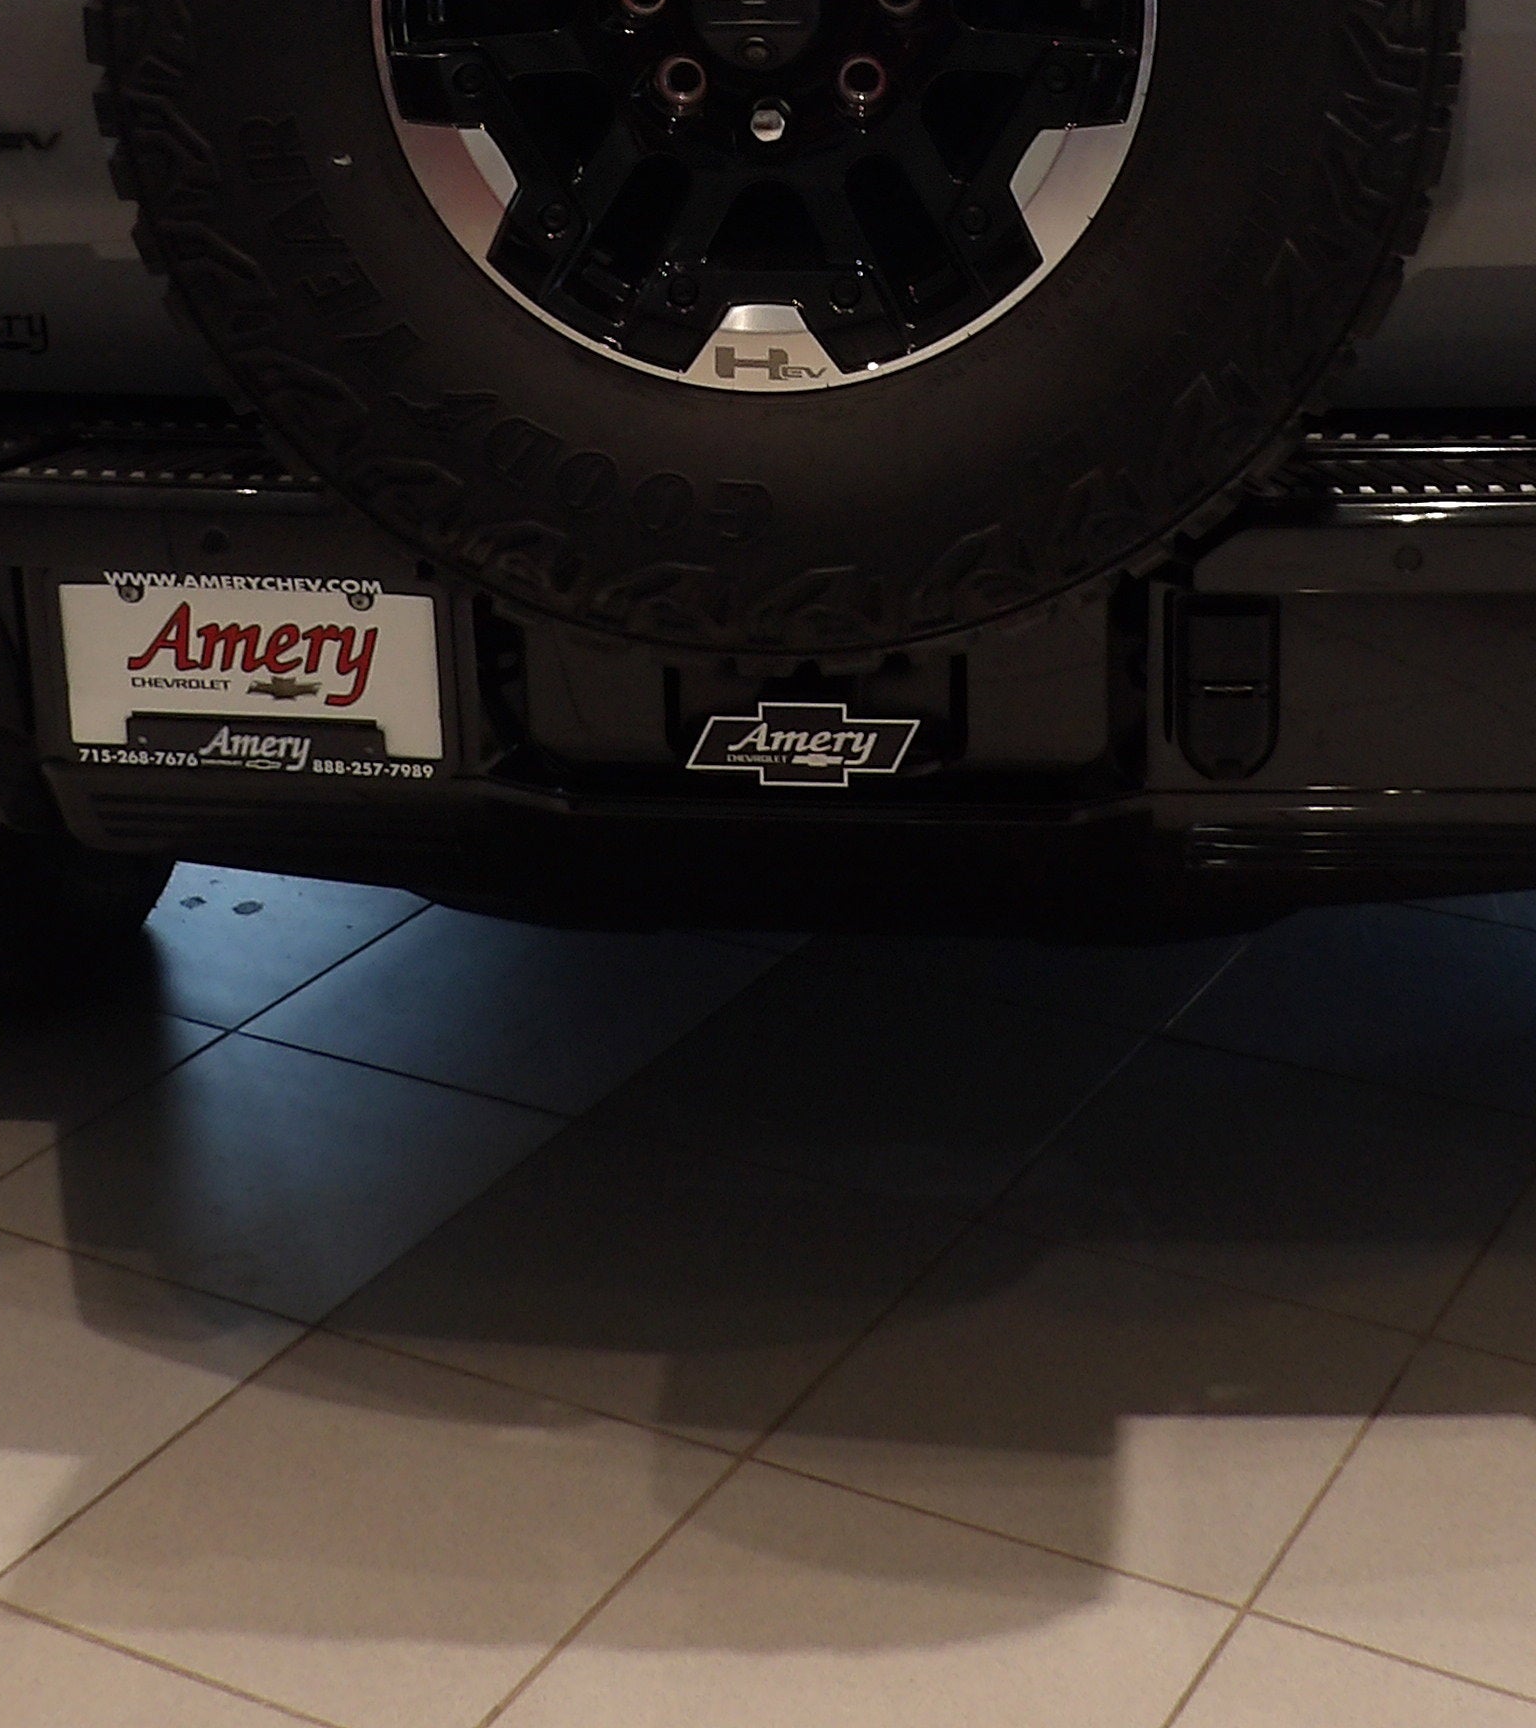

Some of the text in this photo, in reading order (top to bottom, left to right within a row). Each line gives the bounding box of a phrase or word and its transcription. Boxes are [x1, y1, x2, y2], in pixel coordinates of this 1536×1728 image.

[103, 570, 383, 595] WWW.AMERYCHEV.COM
[127, 601, 378, 708] Amery
[131, 676, 232, 692] CHEVROLET
[78, 725, 434, 779] 715-268-7676 Amery 888-257-7989
[727, 721, 879, 765] Amery
